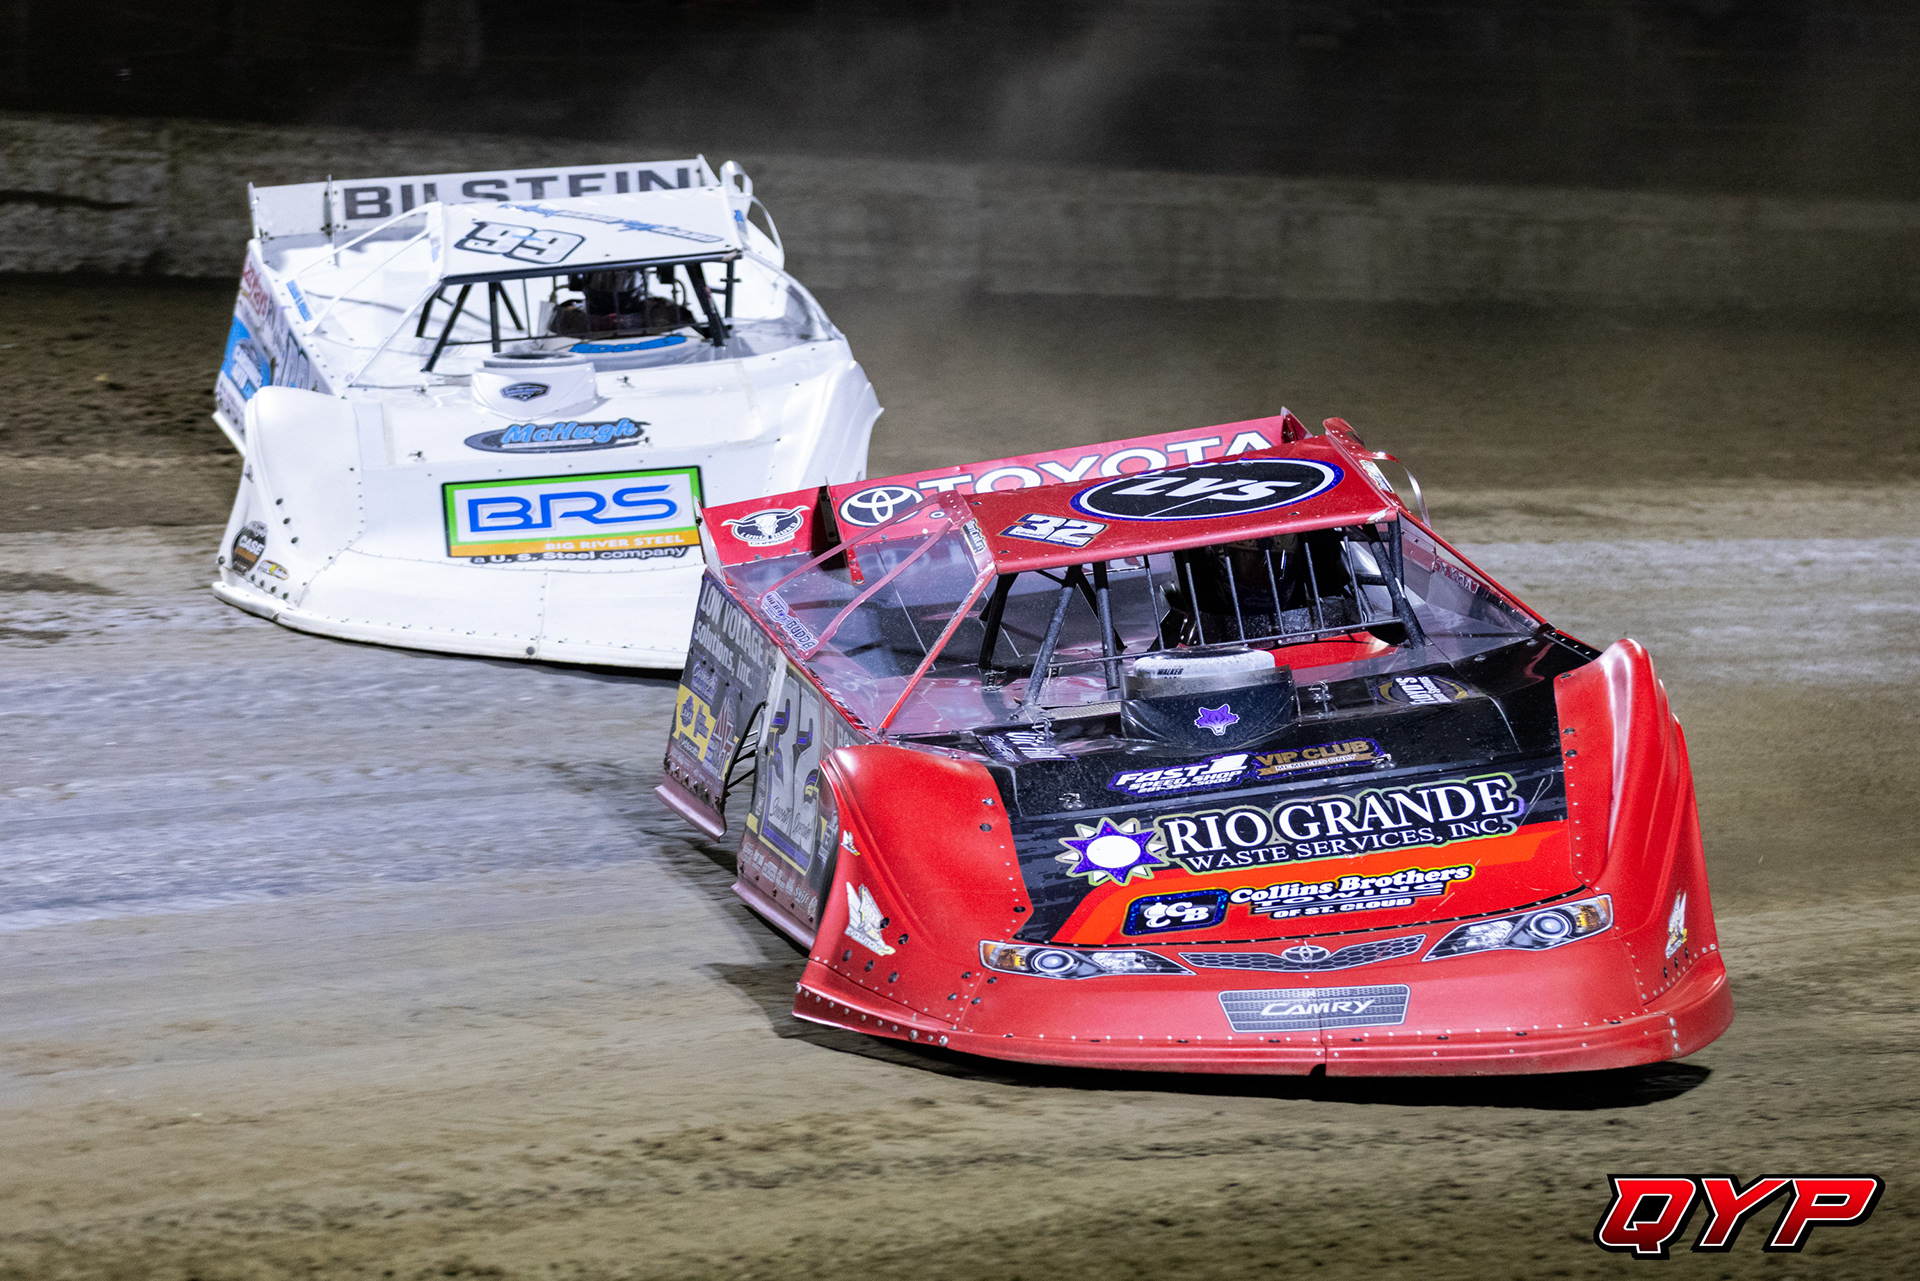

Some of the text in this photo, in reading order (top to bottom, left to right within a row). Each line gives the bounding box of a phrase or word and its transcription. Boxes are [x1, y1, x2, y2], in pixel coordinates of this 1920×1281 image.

[501, 418, 638, 443] McHugh
[917, 430, 1275, 495] TOYOTA
[467, 484, 678, 533] BRS
[545, 534, 685, 551] BIG RIVER STEEL
[1003, 513, 1108, 547] 32
[238, 534, 265, 556] CASE
[474, 545, 686, 564] a U. S. Steel company
[700, 580, 726, 625] LOW
[722, 600, 764, 669] VOLTAGE
[1156, 667, 1185, 676] WALKER
[1255, 740, 1370, 767] VIP CLUB
[1274, 753, 1358, 772] MEMBERS ONLY
[1115, 753, 1249, 786] FAST 1
[1128, 770, 1244, 791] SPEED SHOP
[1164, 778, 1515, 856] RIO GRANDE
[1185, 817, 1507, 871] WASTE SERVICES, INC.
[1230, 867, 1470, 903] Collins Brothers
[1254, 882, 1444, 907] TOWING
[1273, 897, 1412, 918] OF ST. CLOUD
[1260, 999, 1376, 1016] CAMRY
